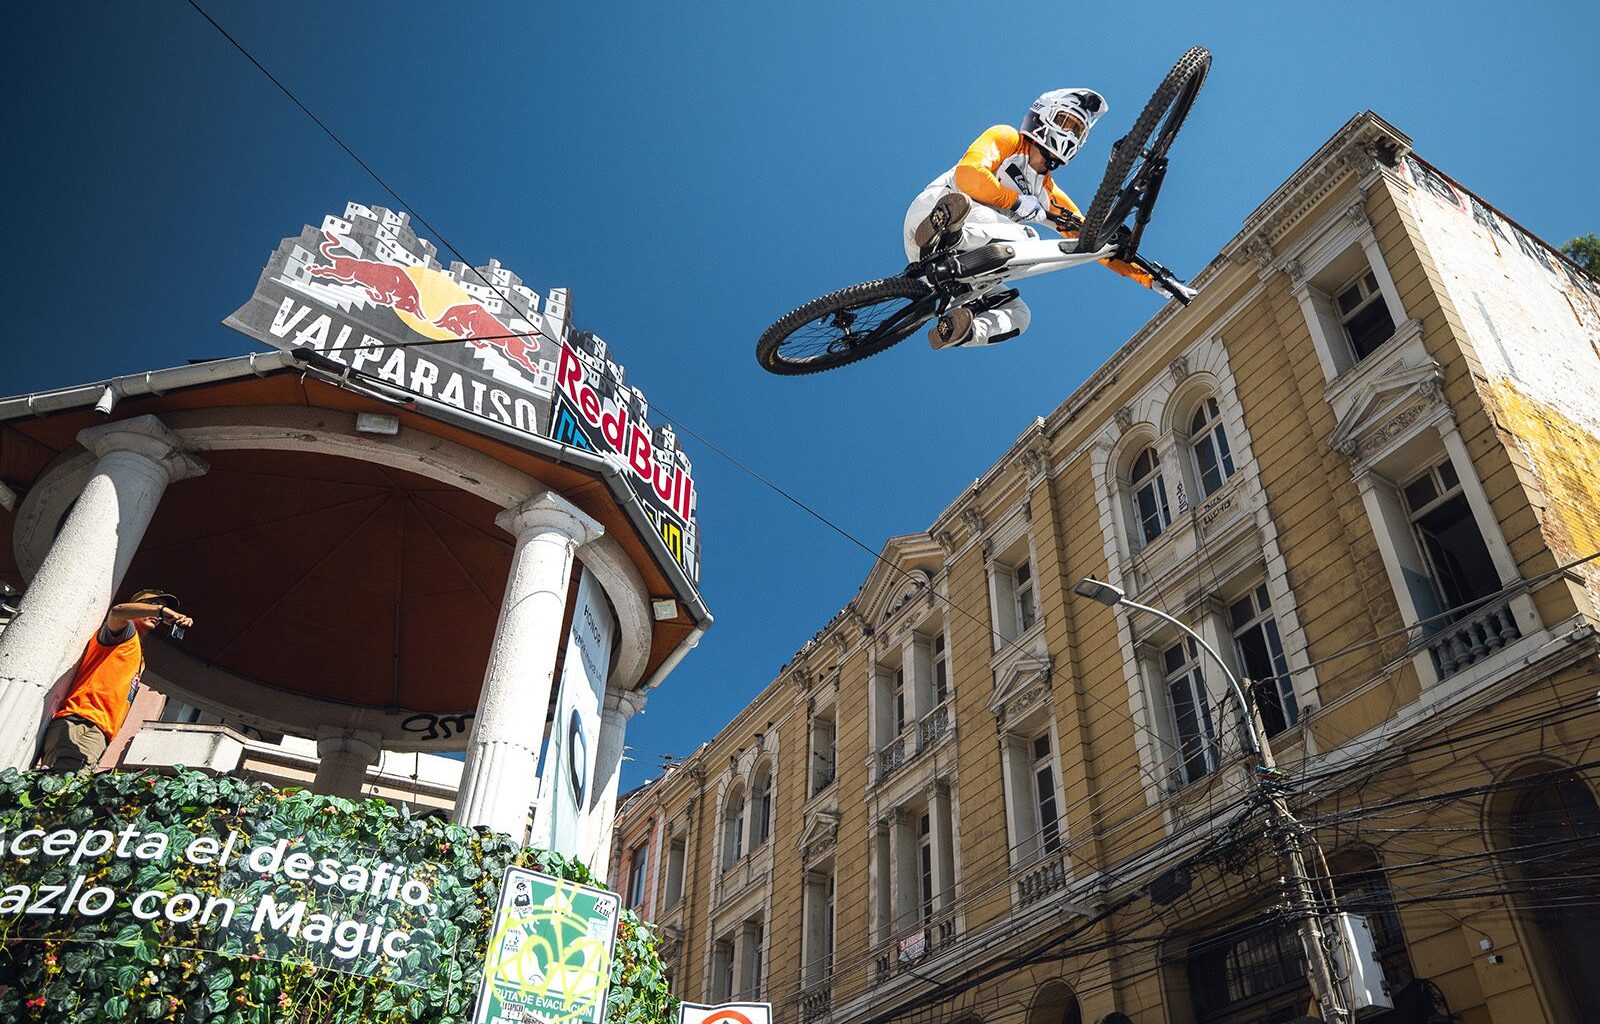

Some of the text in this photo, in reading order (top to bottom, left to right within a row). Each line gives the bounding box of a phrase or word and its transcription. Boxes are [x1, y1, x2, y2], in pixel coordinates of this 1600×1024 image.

[269, 297, 538, 435] VALPARAISO
[556, 338, 628, 457] Red
[629, 425, 692, 523] Bull
[583, 603, 601, 648] HONOR
[186, 830, 236, 867] el
[250, 838, 437, 916] desafío,
[0, 874, 411, 959] azlo con Magic
[496, 988, 518, 1001] RUTA
[521, 993, 534, 1005] DE
[535, 996, 593, 1017] EVACUCIN
